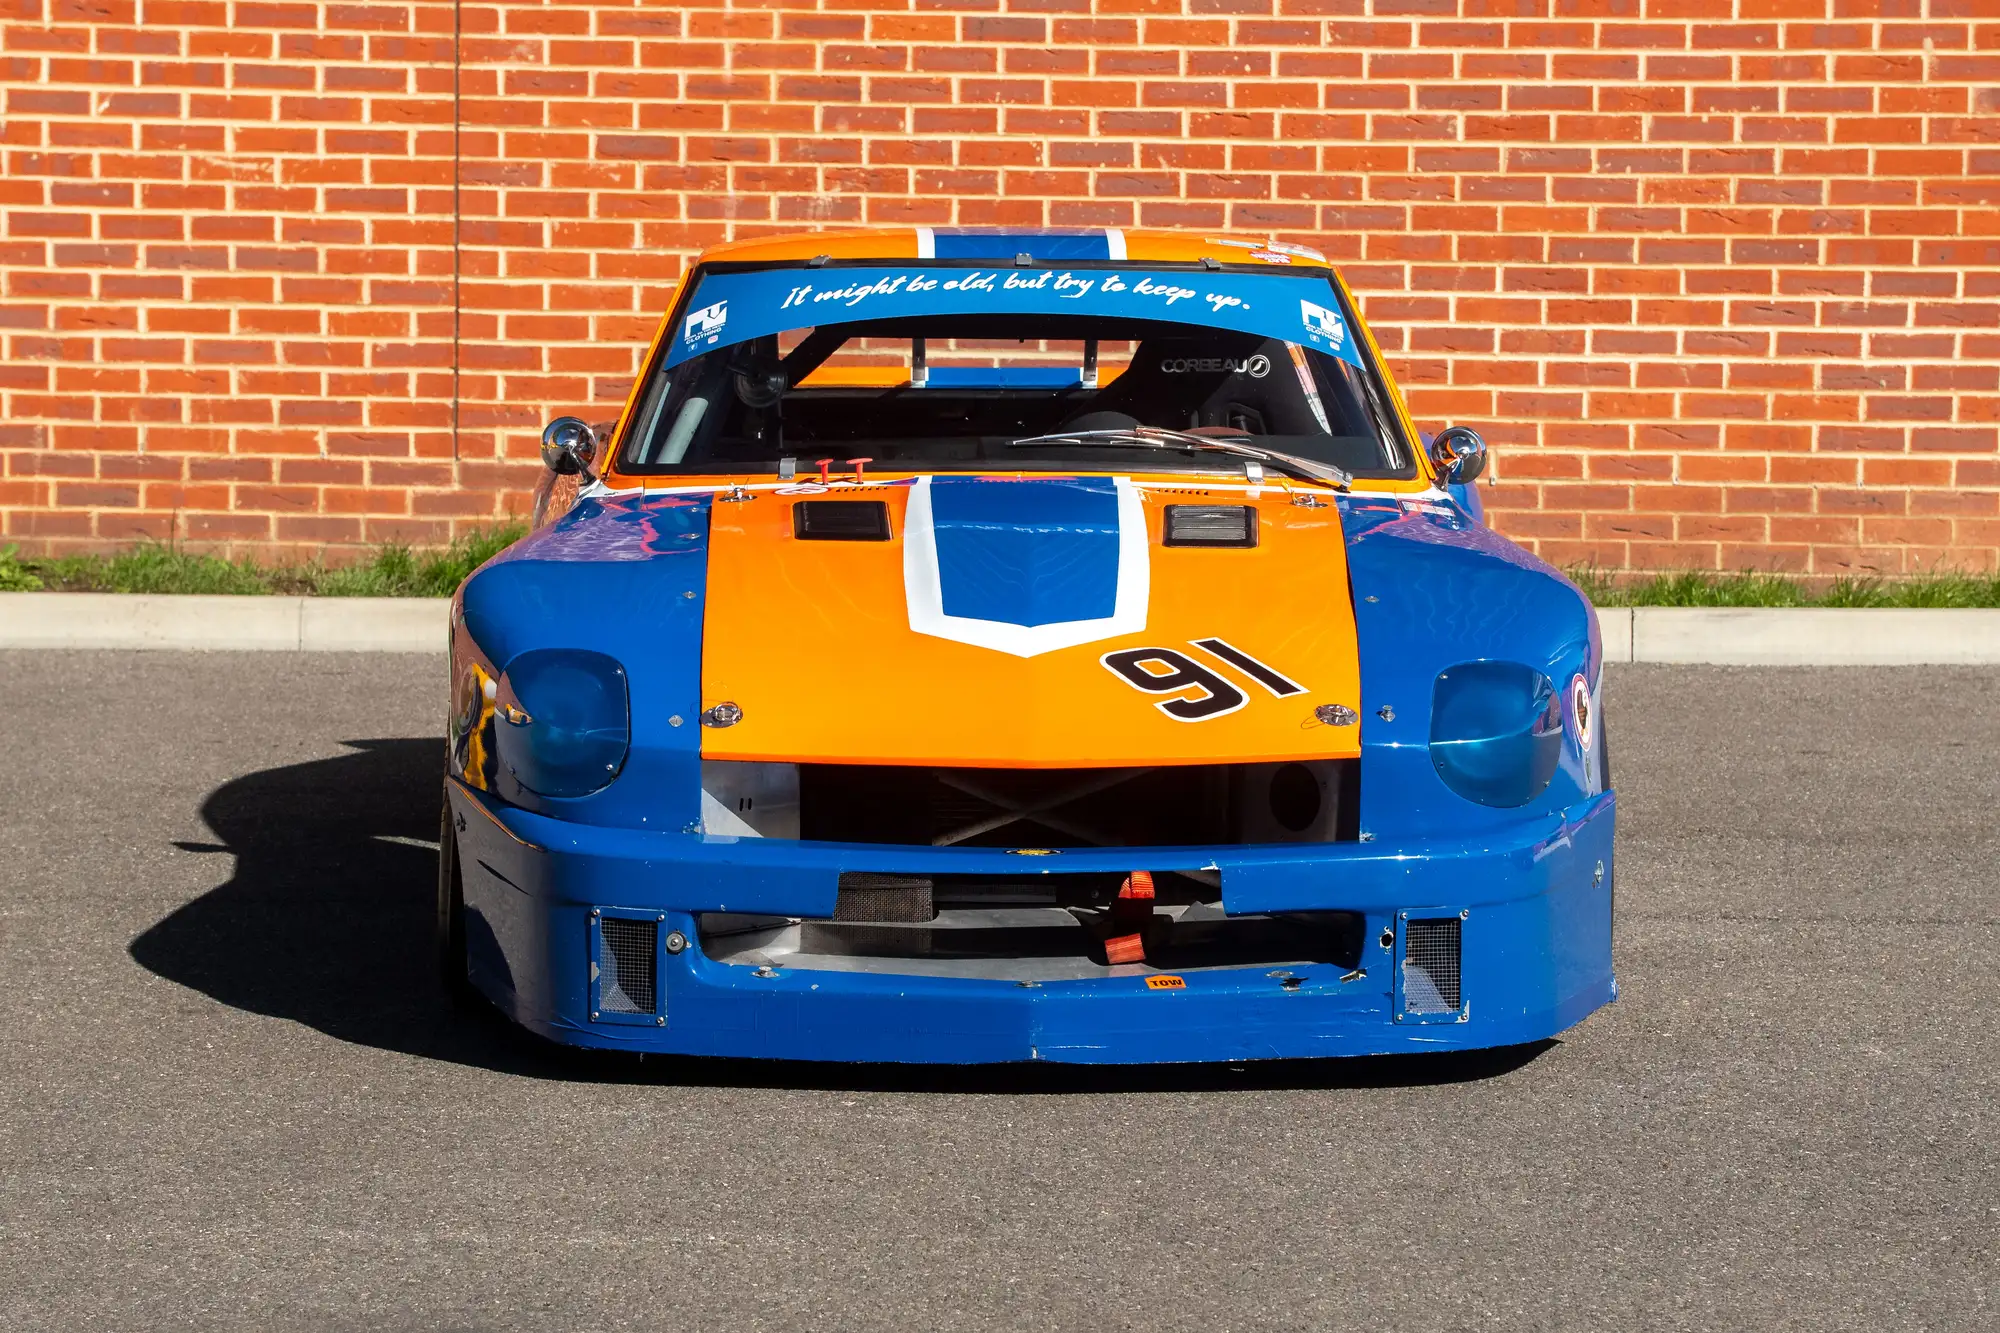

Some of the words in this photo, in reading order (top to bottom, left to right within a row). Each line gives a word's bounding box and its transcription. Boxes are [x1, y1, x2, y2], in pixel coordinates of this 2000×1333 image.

[780, 285, 812, 309] It
[814, 276, 906, 307] might
[905, 274, 938, 292] be
[942, 271, 997, 292] old,
[1003, 271, 1053, 289] but
[1054, 273, 1094, 298] try
[1100, 274, 1127, 292] to
[1132, 277, 1196, 305] keep
[1205, 293, 1250, 312] up.
[1161, 358, 1248, 373] CORBEAU
[1099, 636, 1312, 723] 91
[1149, 979, 1182, 987] TOW
